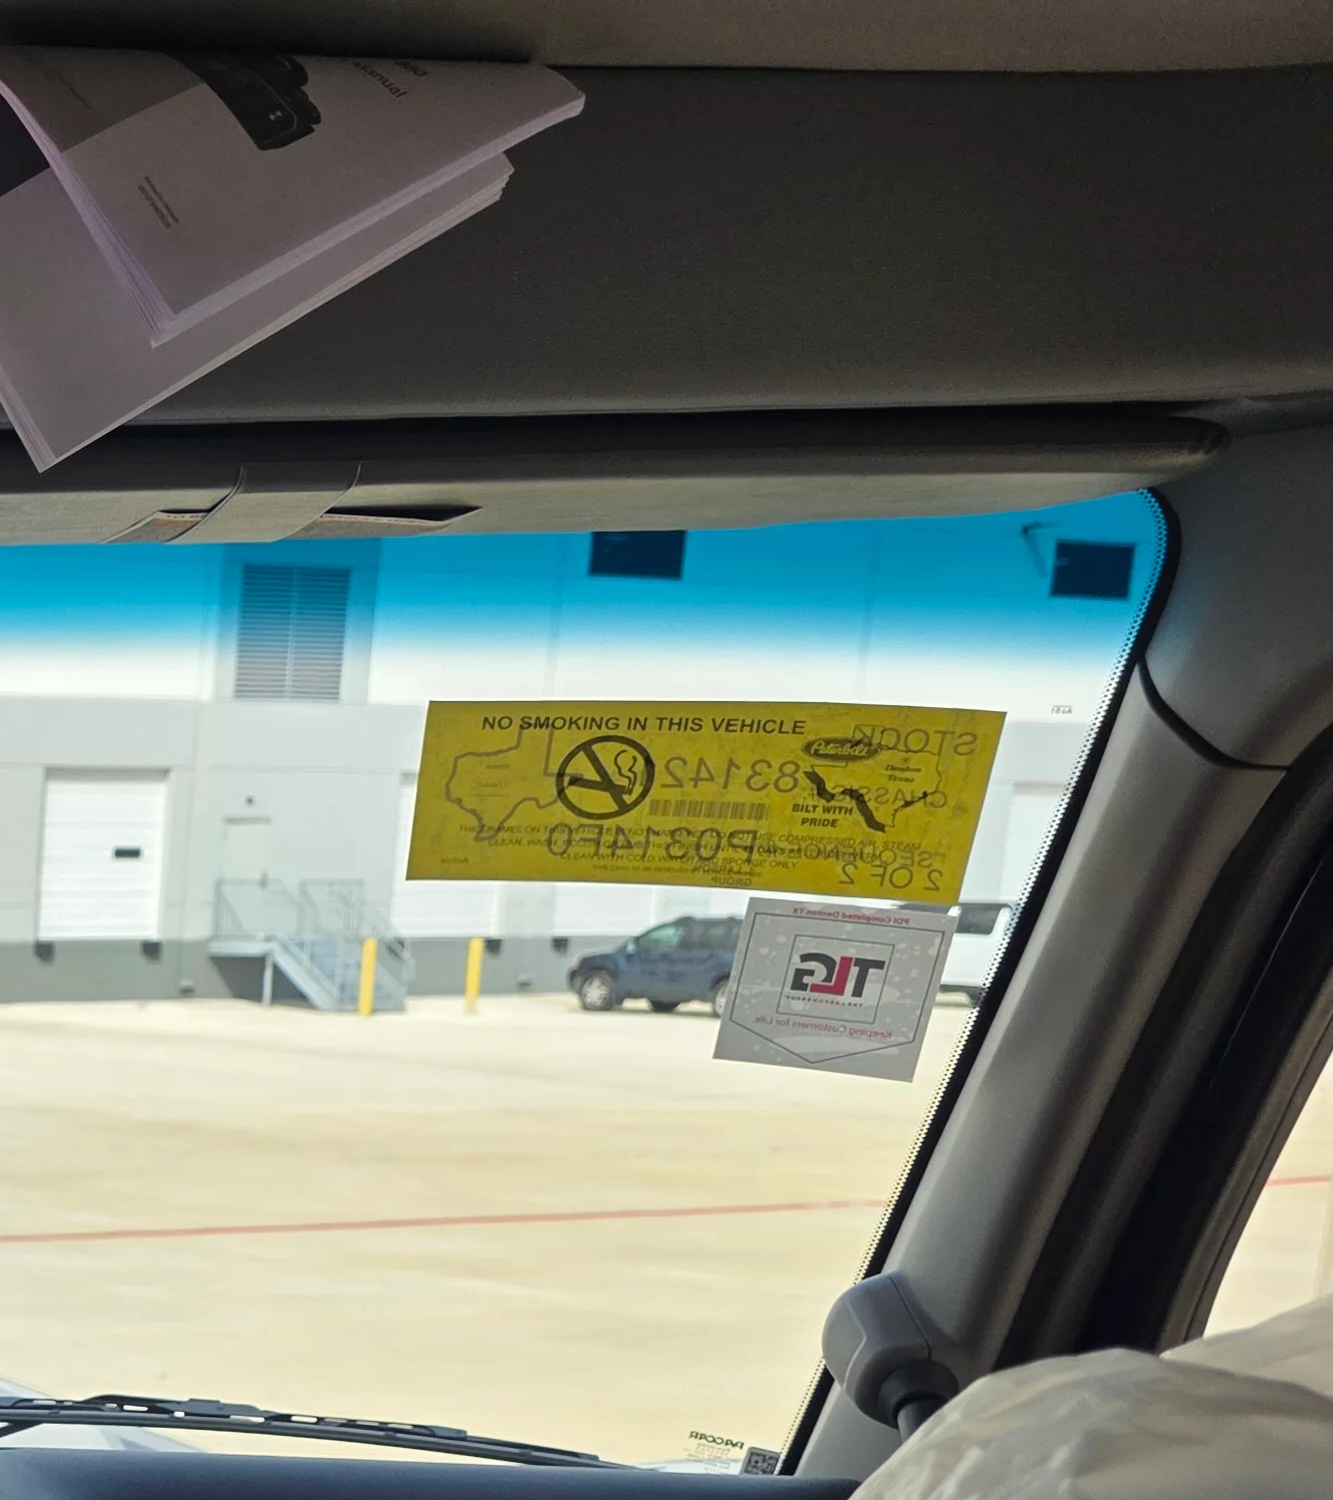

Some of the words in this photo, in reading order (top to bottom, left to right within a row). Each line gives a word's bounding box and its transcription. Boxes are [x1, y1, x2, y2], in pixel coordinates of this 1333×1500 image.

[482, 716, 513, 730] NO
[519, 716, 620, 731] SMOKING
[627, 717, 649, 731] IN
[656, 717, 704, 732] THIS
[711, 718, 807, 735] VEHICLE
[810, 739, 874, 758] Peterbilt
[792, 803, 820, 814] BILT
[822, 804, 854, 816] WITH
[800, 817, 839, 829] PRIDE
[769, 859, 799, 869] ONLY
